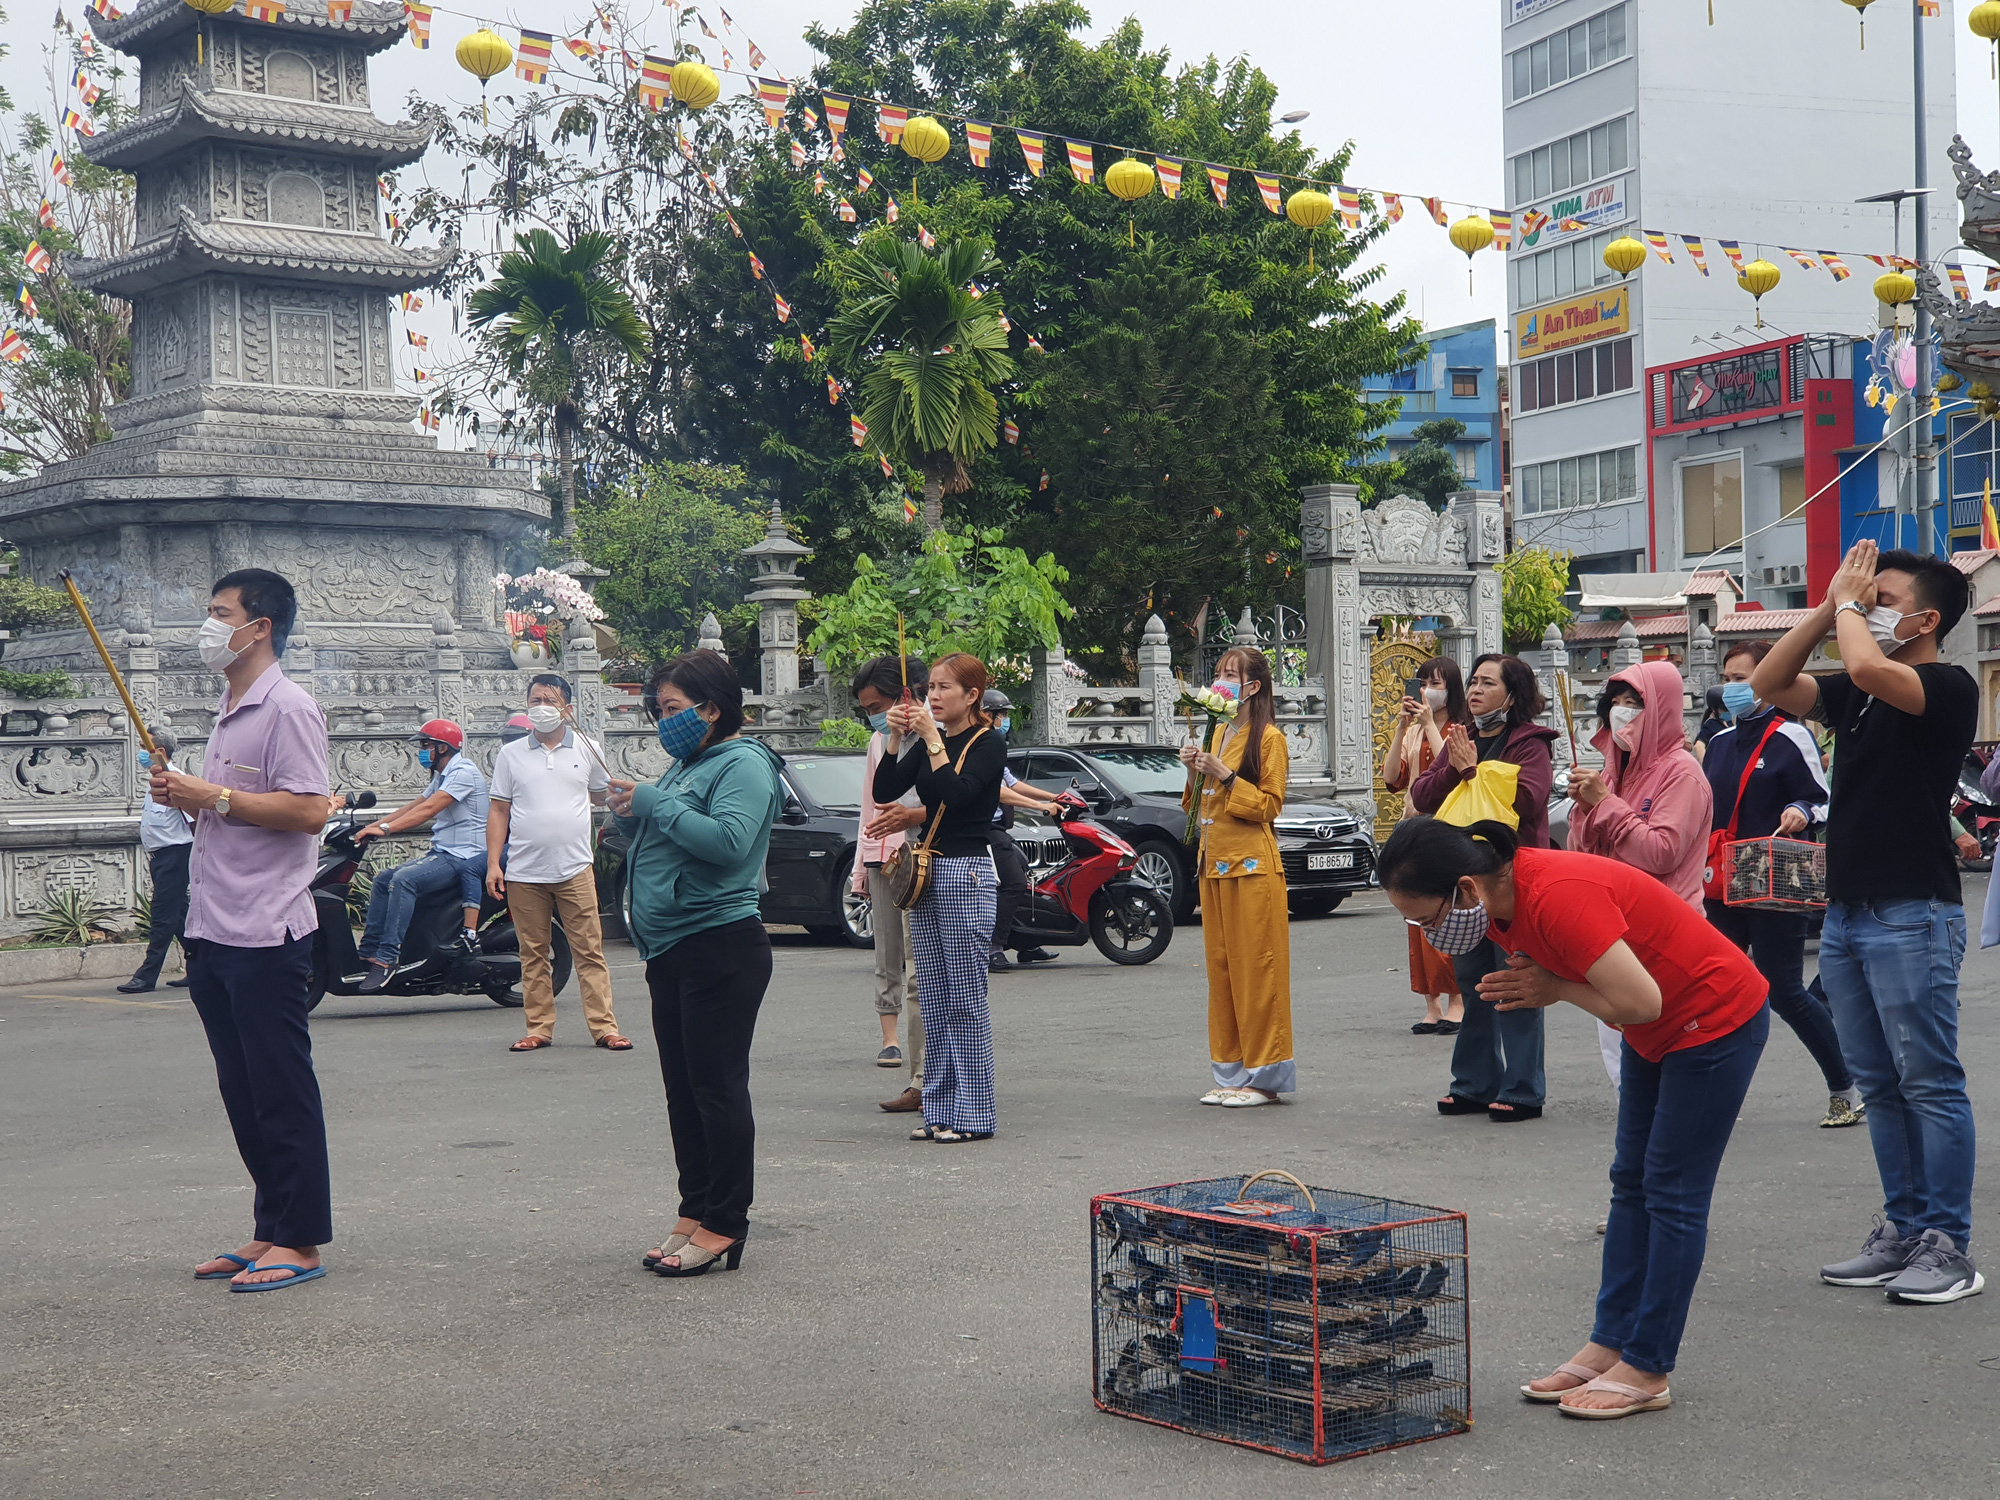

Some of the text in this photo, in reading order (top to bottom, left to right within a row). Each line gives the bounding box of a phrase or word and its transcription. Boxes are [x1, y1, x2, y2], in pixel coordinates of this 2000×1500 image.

[1551, 195, 1582, 220] VINA
[1585, 184, 1615, 210] ATM
[1755, 367, 1778, 384] CHAY
